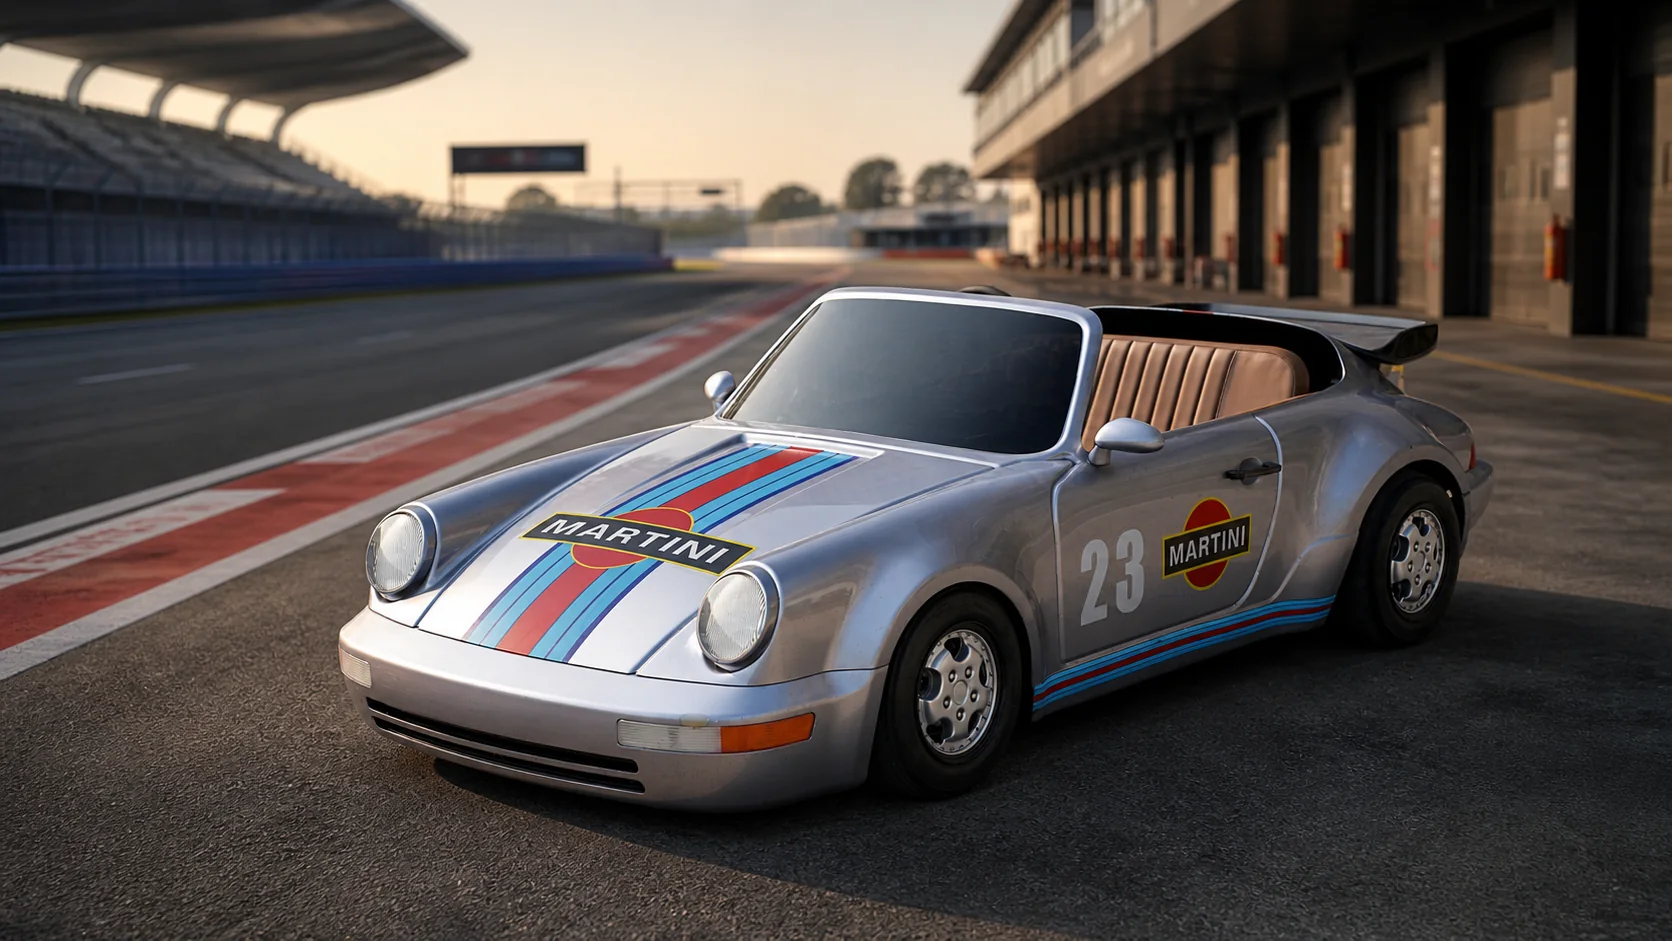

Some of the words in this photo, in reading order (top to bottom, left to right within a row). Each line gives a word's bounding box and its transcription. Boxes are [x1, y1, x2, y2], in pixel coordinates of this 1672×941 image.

[541, 518, 730, 564] MARTINI
[1169, 525, 1246, 567] MARTINI
[1080, 528, 1145, 627] 23
